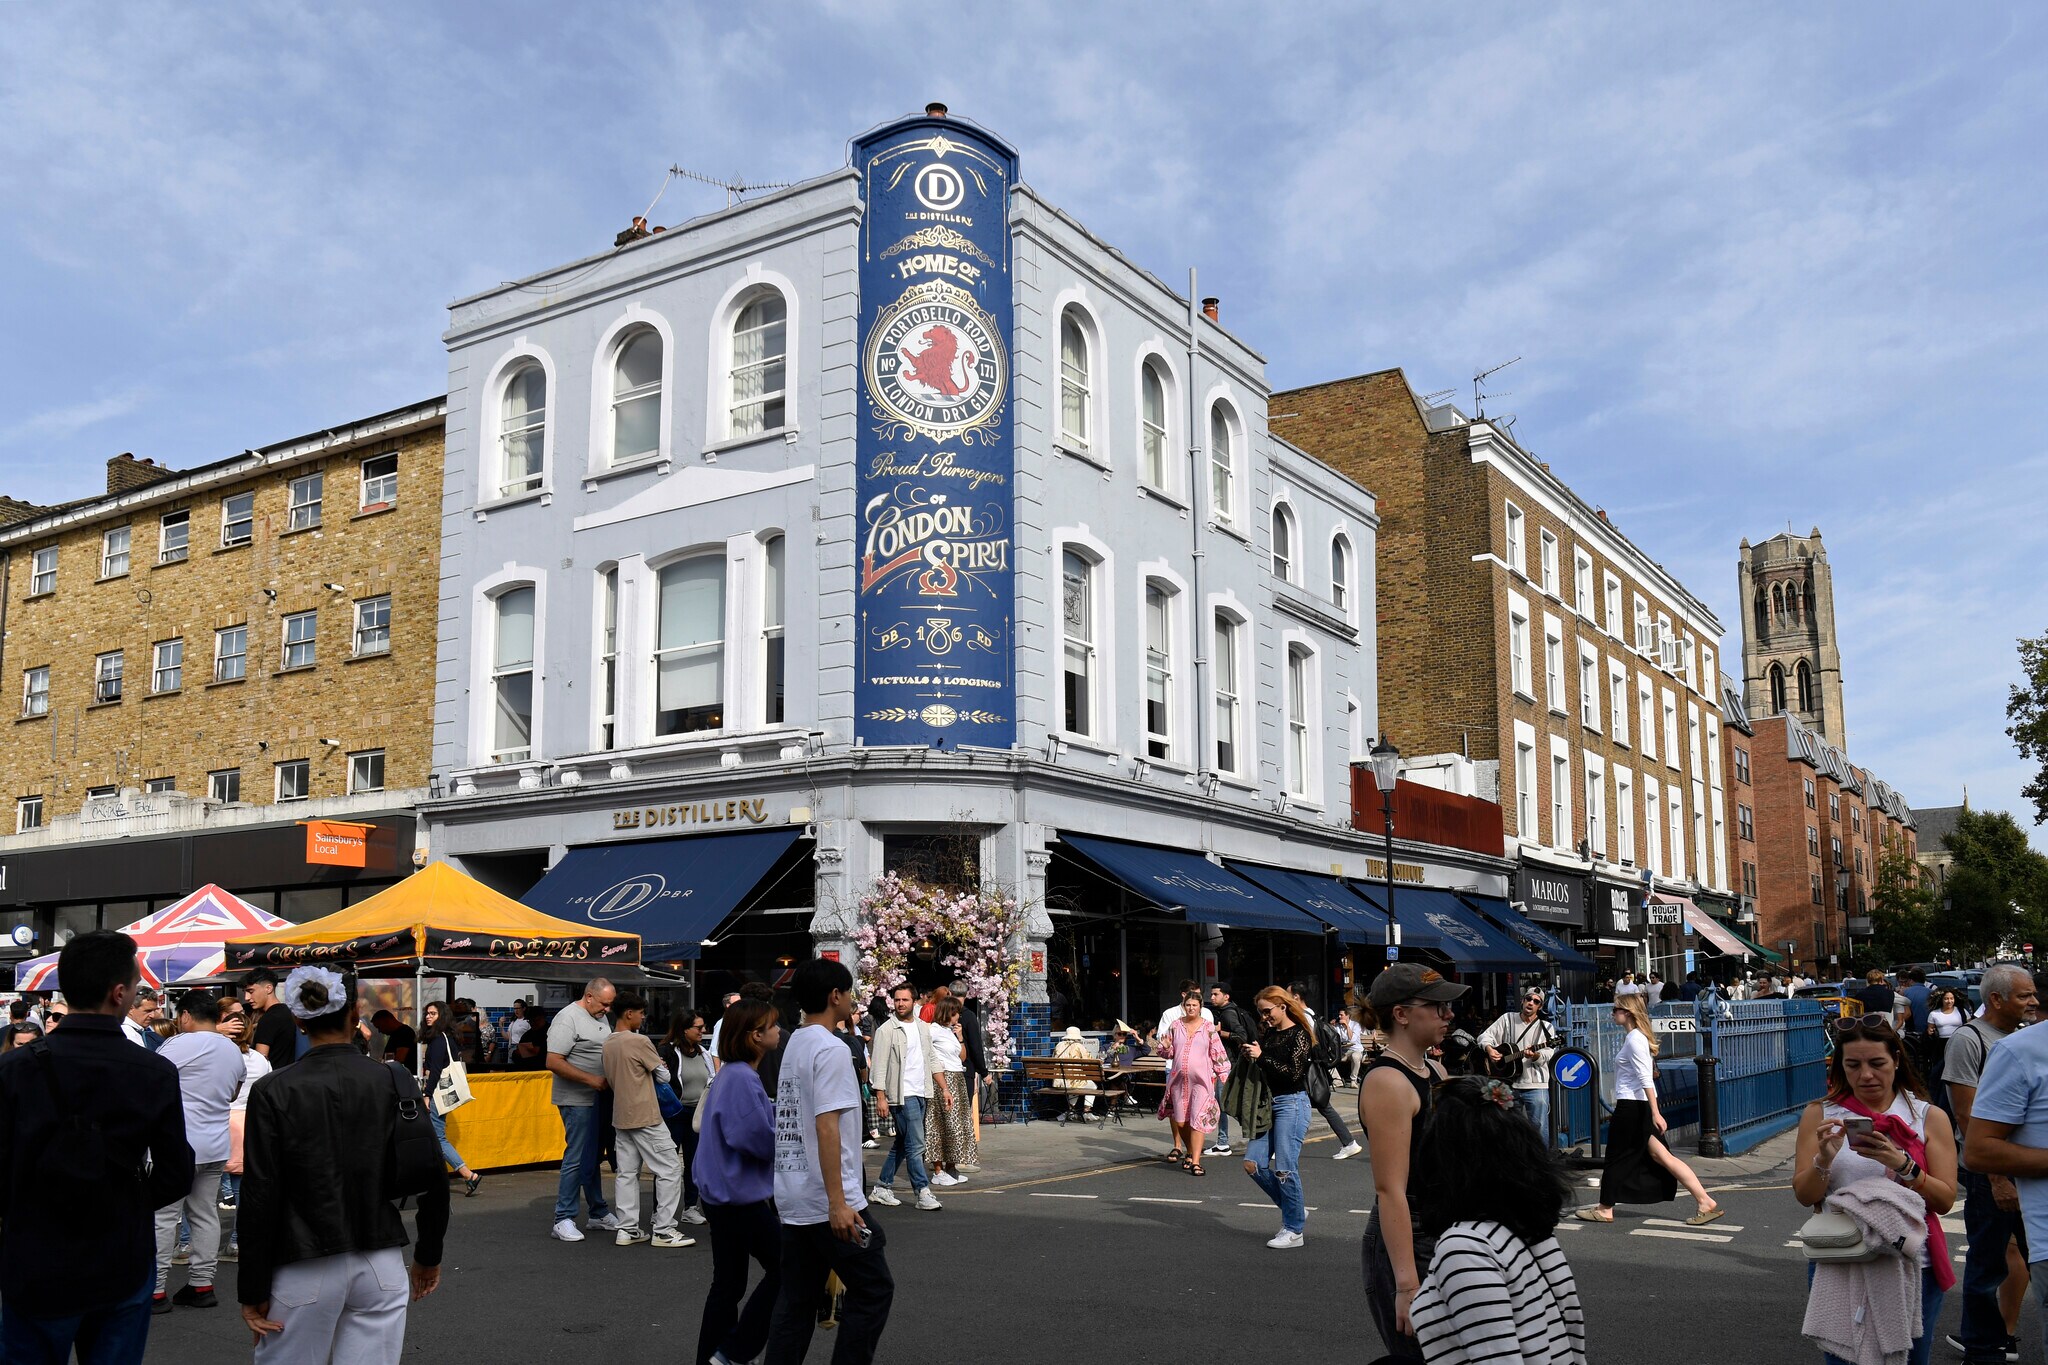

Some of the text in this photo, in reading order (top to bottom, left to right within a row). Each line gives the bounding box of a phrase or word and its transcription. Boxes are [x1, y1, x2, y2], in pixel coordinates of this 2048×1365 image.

[928, 172, 955, 200] D
[920, 212, 973, 226] DISTILLERY
[898, 254, 981, 279] HOME OF
[885, 307, 991, 352] PORTOBELLO ROAD
[980, 363, 995, 378] 171
[884, 382, 991, 422] LONDON DRY GIN
[865, 451, 1006, 490] Proud Purveyors
[930, 494, 947, 505] OF
[861, 492, 974, 595] LONDON
[919, 539, 1010, 595] SPIRIT
[881, 618, 992, 655] PB 186 RD
[871, 676, 1002, 689] VICTUALS & LODGINGS
[613, 798, 769, 828] THE DISTILLERY
[315, 832, 363, 847] Sainsbury's
[315, 844, 338, 855] Local
[599, 883, 652, 912] D
[660, 889, 693, 898] PBR
[1531, 879, 1569, 903] MARIOS
[1652, 905, 1677, 914] ROUGH
